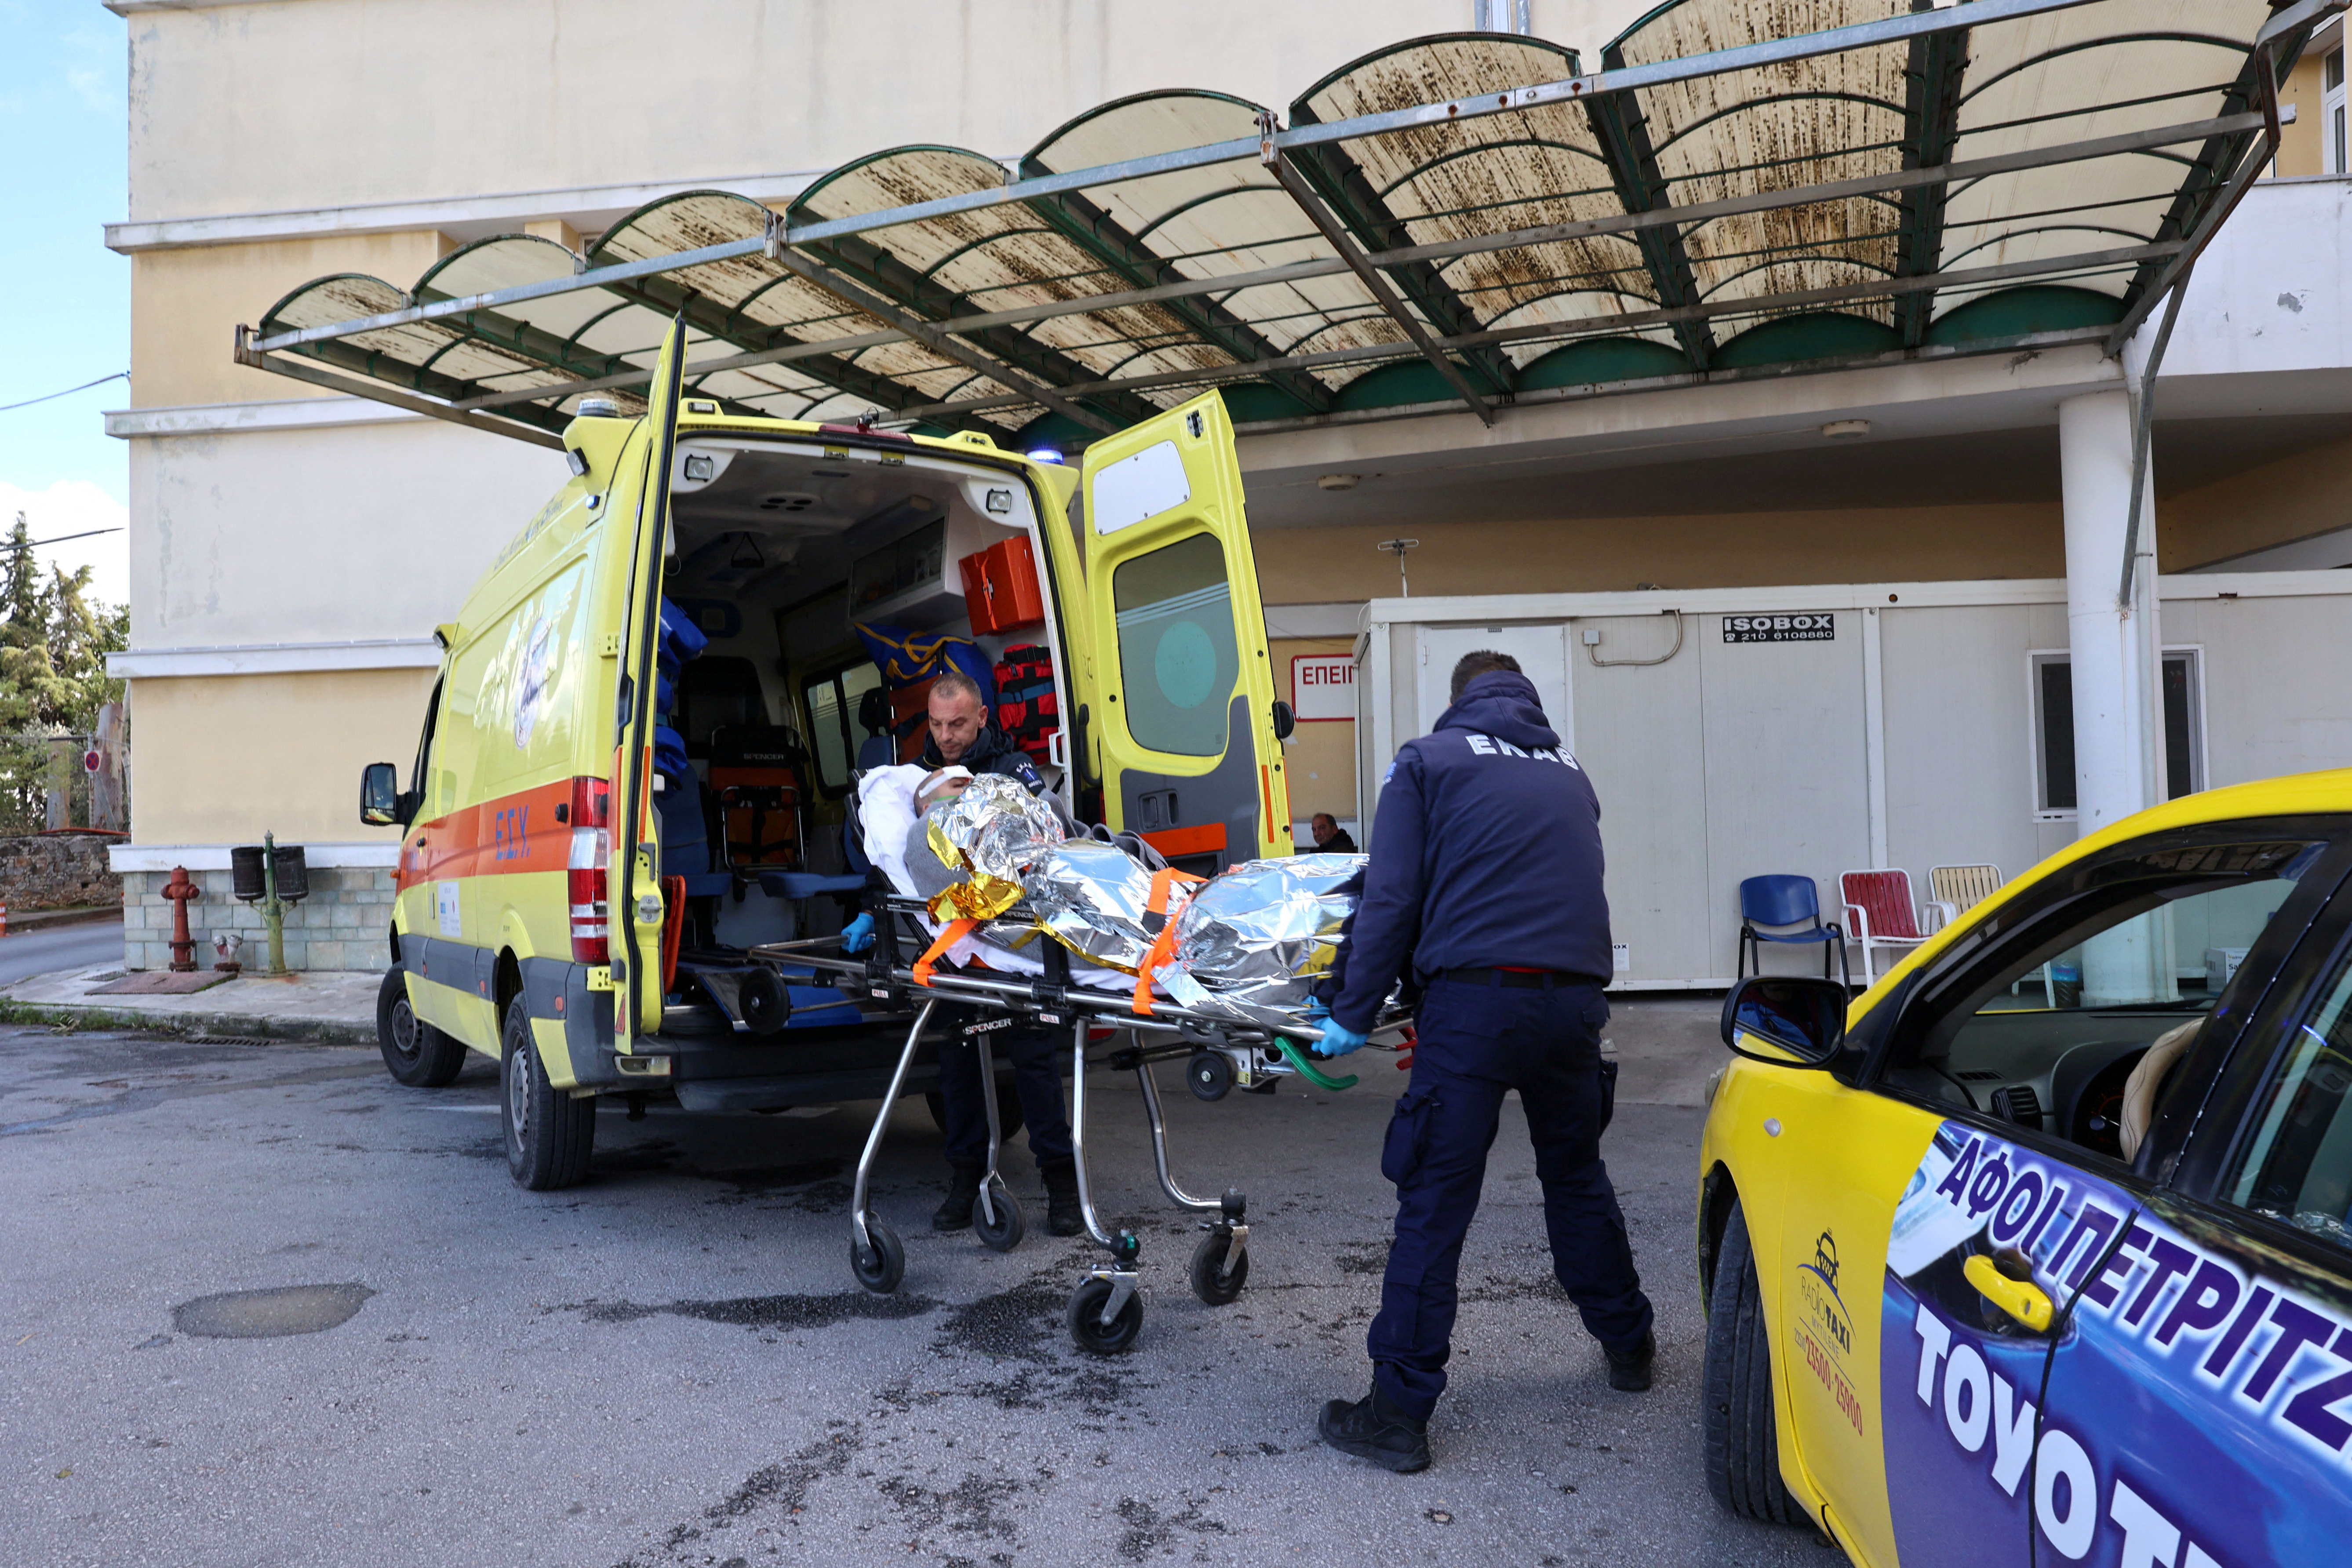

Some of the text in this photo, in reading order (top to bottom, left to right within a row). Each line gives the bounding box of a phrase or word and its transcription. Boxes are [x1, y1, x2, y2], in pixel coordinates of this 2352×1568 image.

[1724, 616, 1832, 631] ISOBOX
[1741, 630, 1833, 641] 210 6108880
[1005, 910, 1034, 919] SPENCE
[965, 1018, 1012, 1035] SPENCER
[1041, 1014, 1057, 1023] PULL
[1936, 1138, 2064, 1258] ΑΦΟΙ
[1812, 1315, 1839, 1360] MYTILENE
[1915, 1303, 2223, 1568] TOYOT
